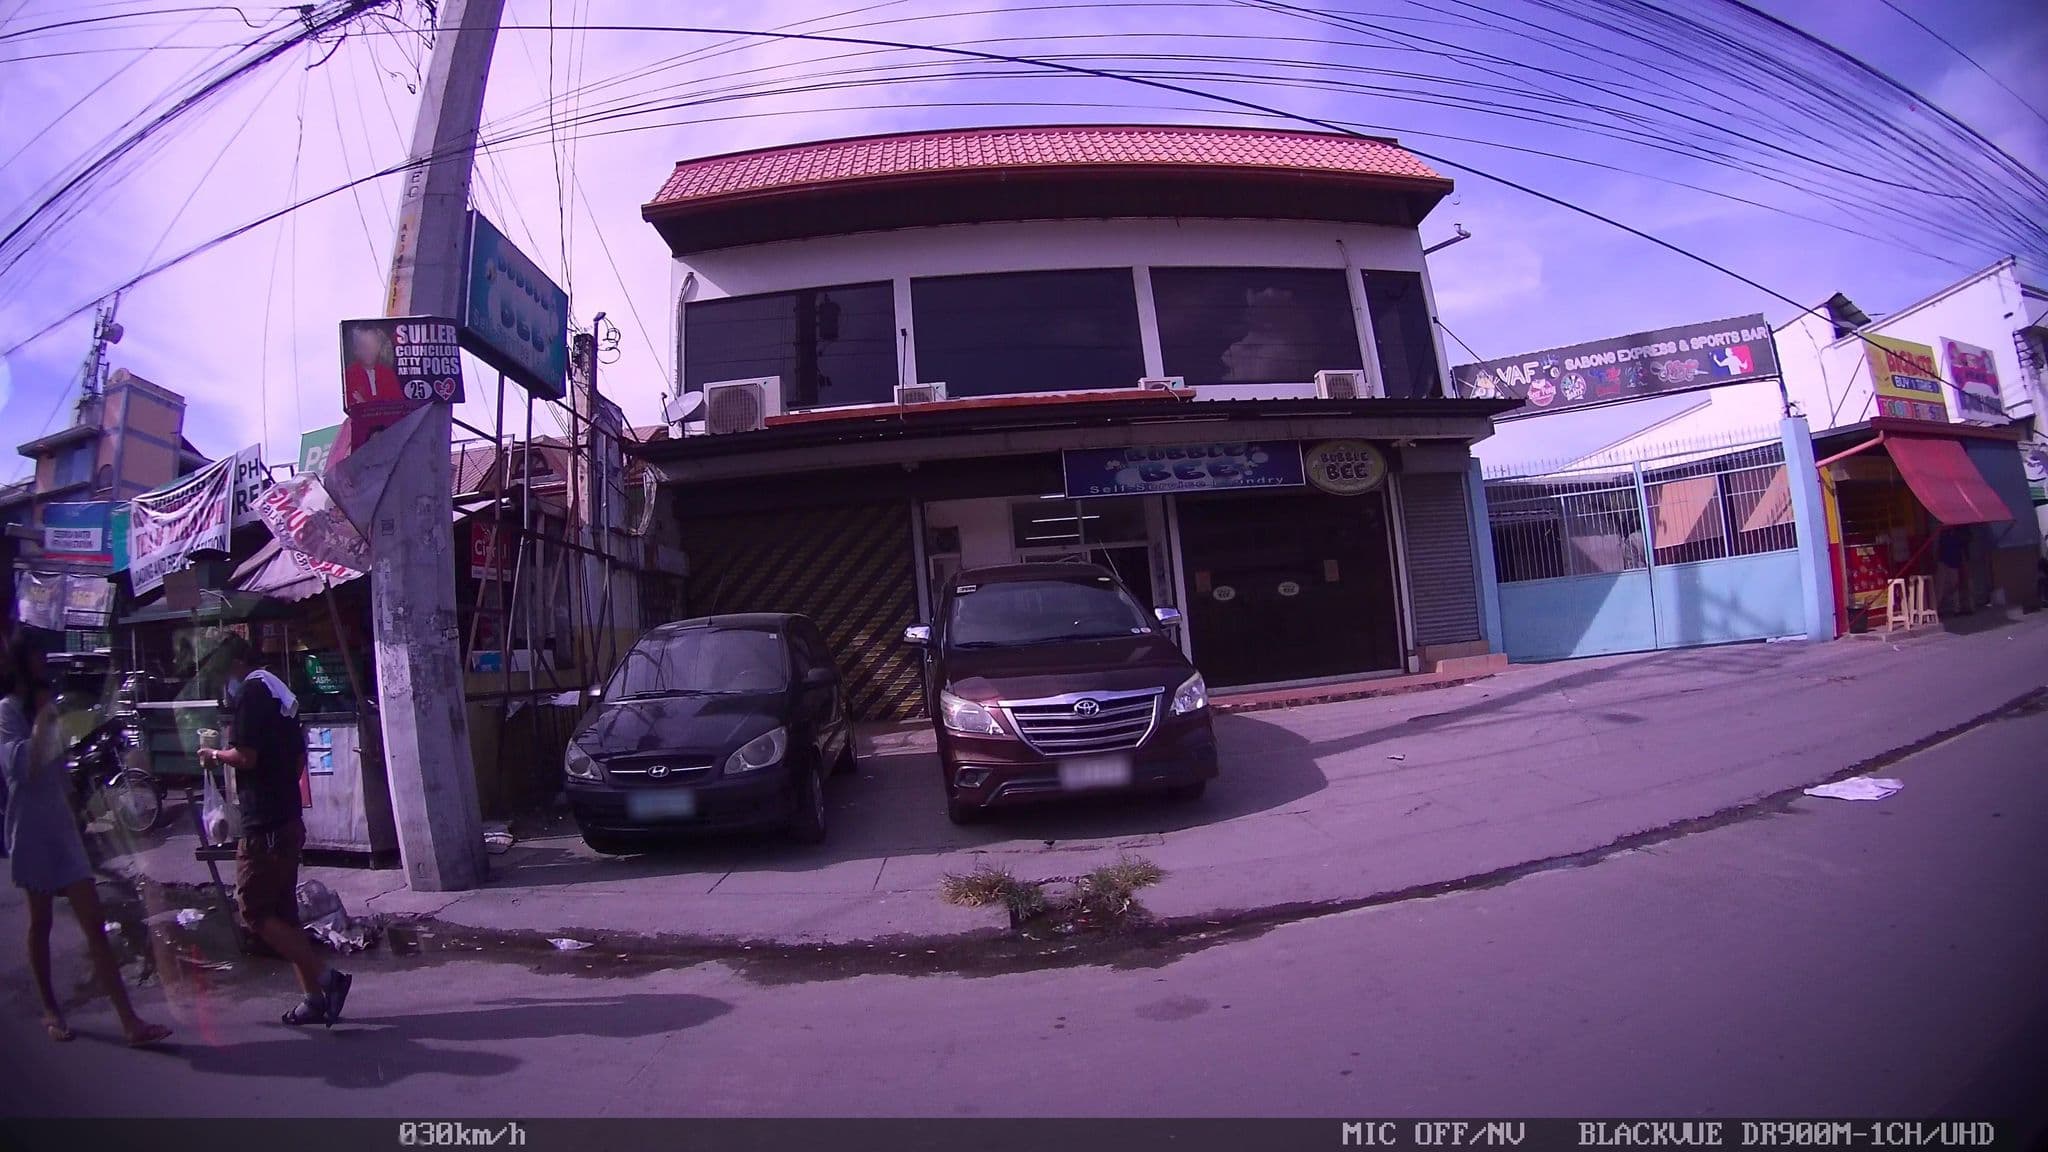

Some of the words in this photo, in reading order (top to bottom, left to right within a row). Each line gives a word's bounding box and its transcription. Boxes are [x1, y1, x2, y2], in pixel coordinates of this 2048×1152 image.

[396, 323, 457, 344] SULLER
[395, 345, 459, 357] COUNCILOR
[1565, 350, 1617, 371] SABONG
[1617, 340, 1677, 363] EXPRESS
[1678, 339, 1690, 352] &
[1691, 331, 1740, 350] SPORTS
[1741, 326, 1768, 343] BAR
[398, 357, 421, 366] ATTY
[422, 357, 460, 375] POGS
[410, 381, 425, 399] 25
[1325, 462, 1369, 481] BEE
